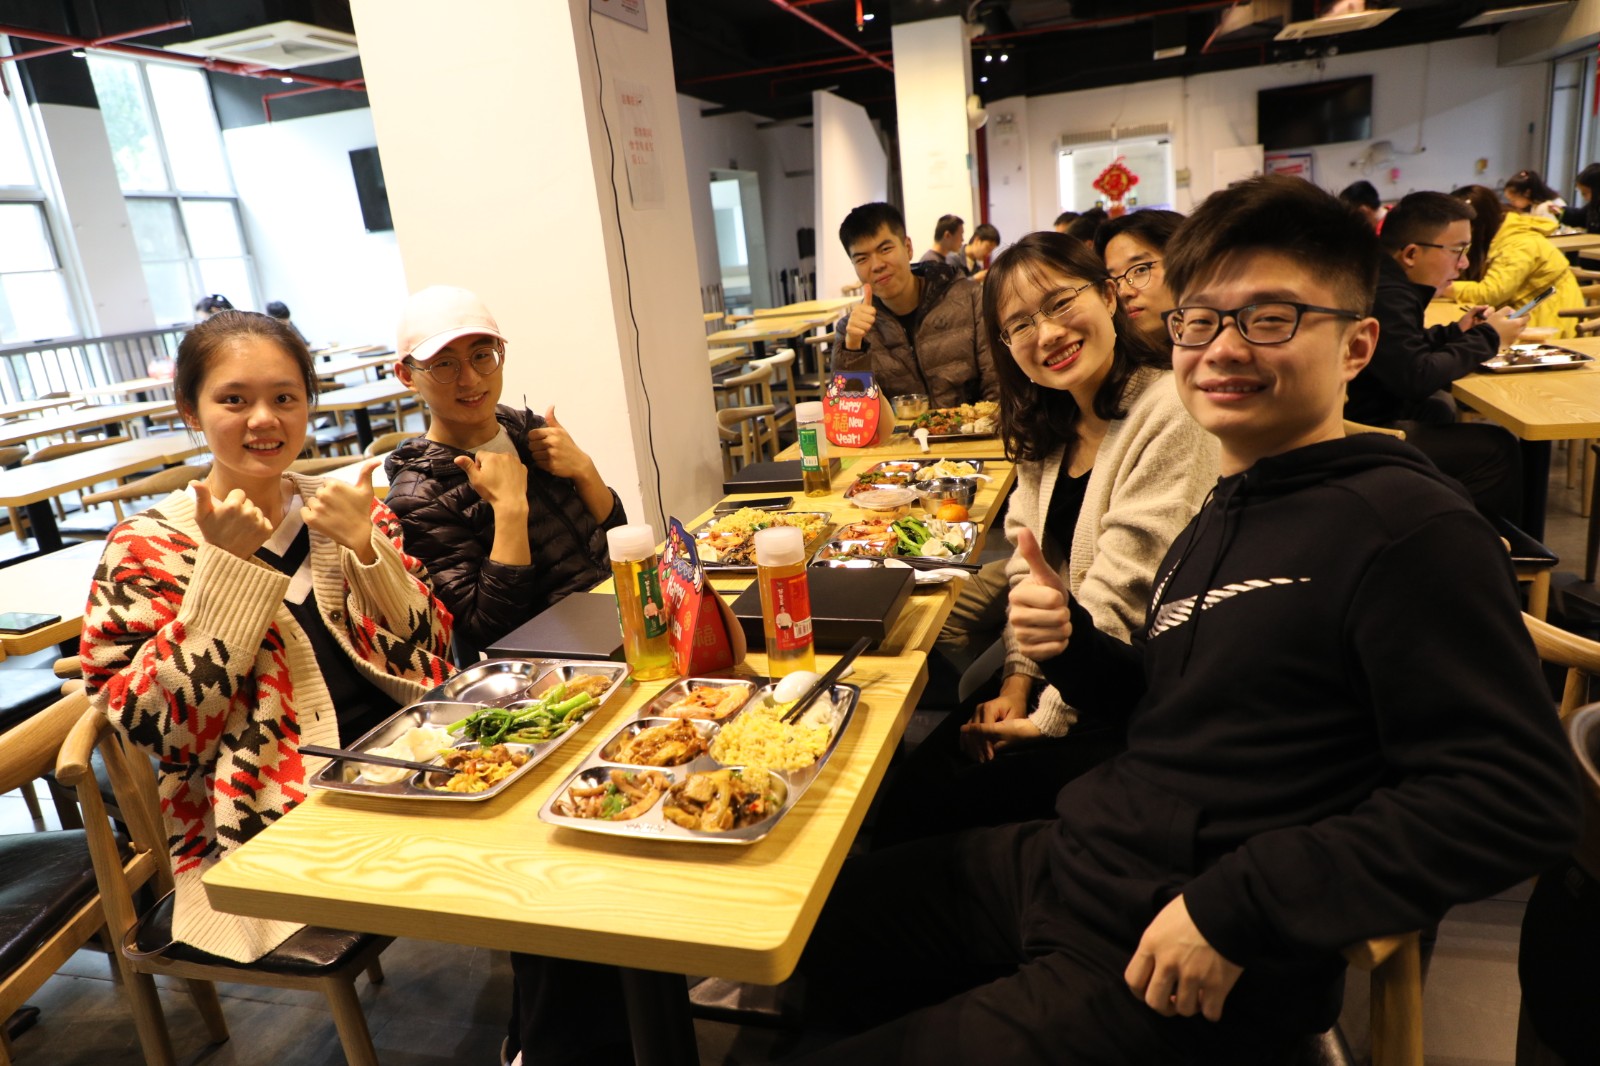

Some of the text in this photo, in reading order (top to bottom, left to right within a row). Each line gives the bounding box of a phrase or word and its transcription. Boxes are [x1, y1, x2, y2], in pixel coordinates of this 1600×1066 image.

[839, 400, 861, 413] Happy
[832, 413, 849, 432] 福
[848, 417, 864, 428] New
[666, 574, 686, 609] Happy
[694, 624, 716, 648] 福
